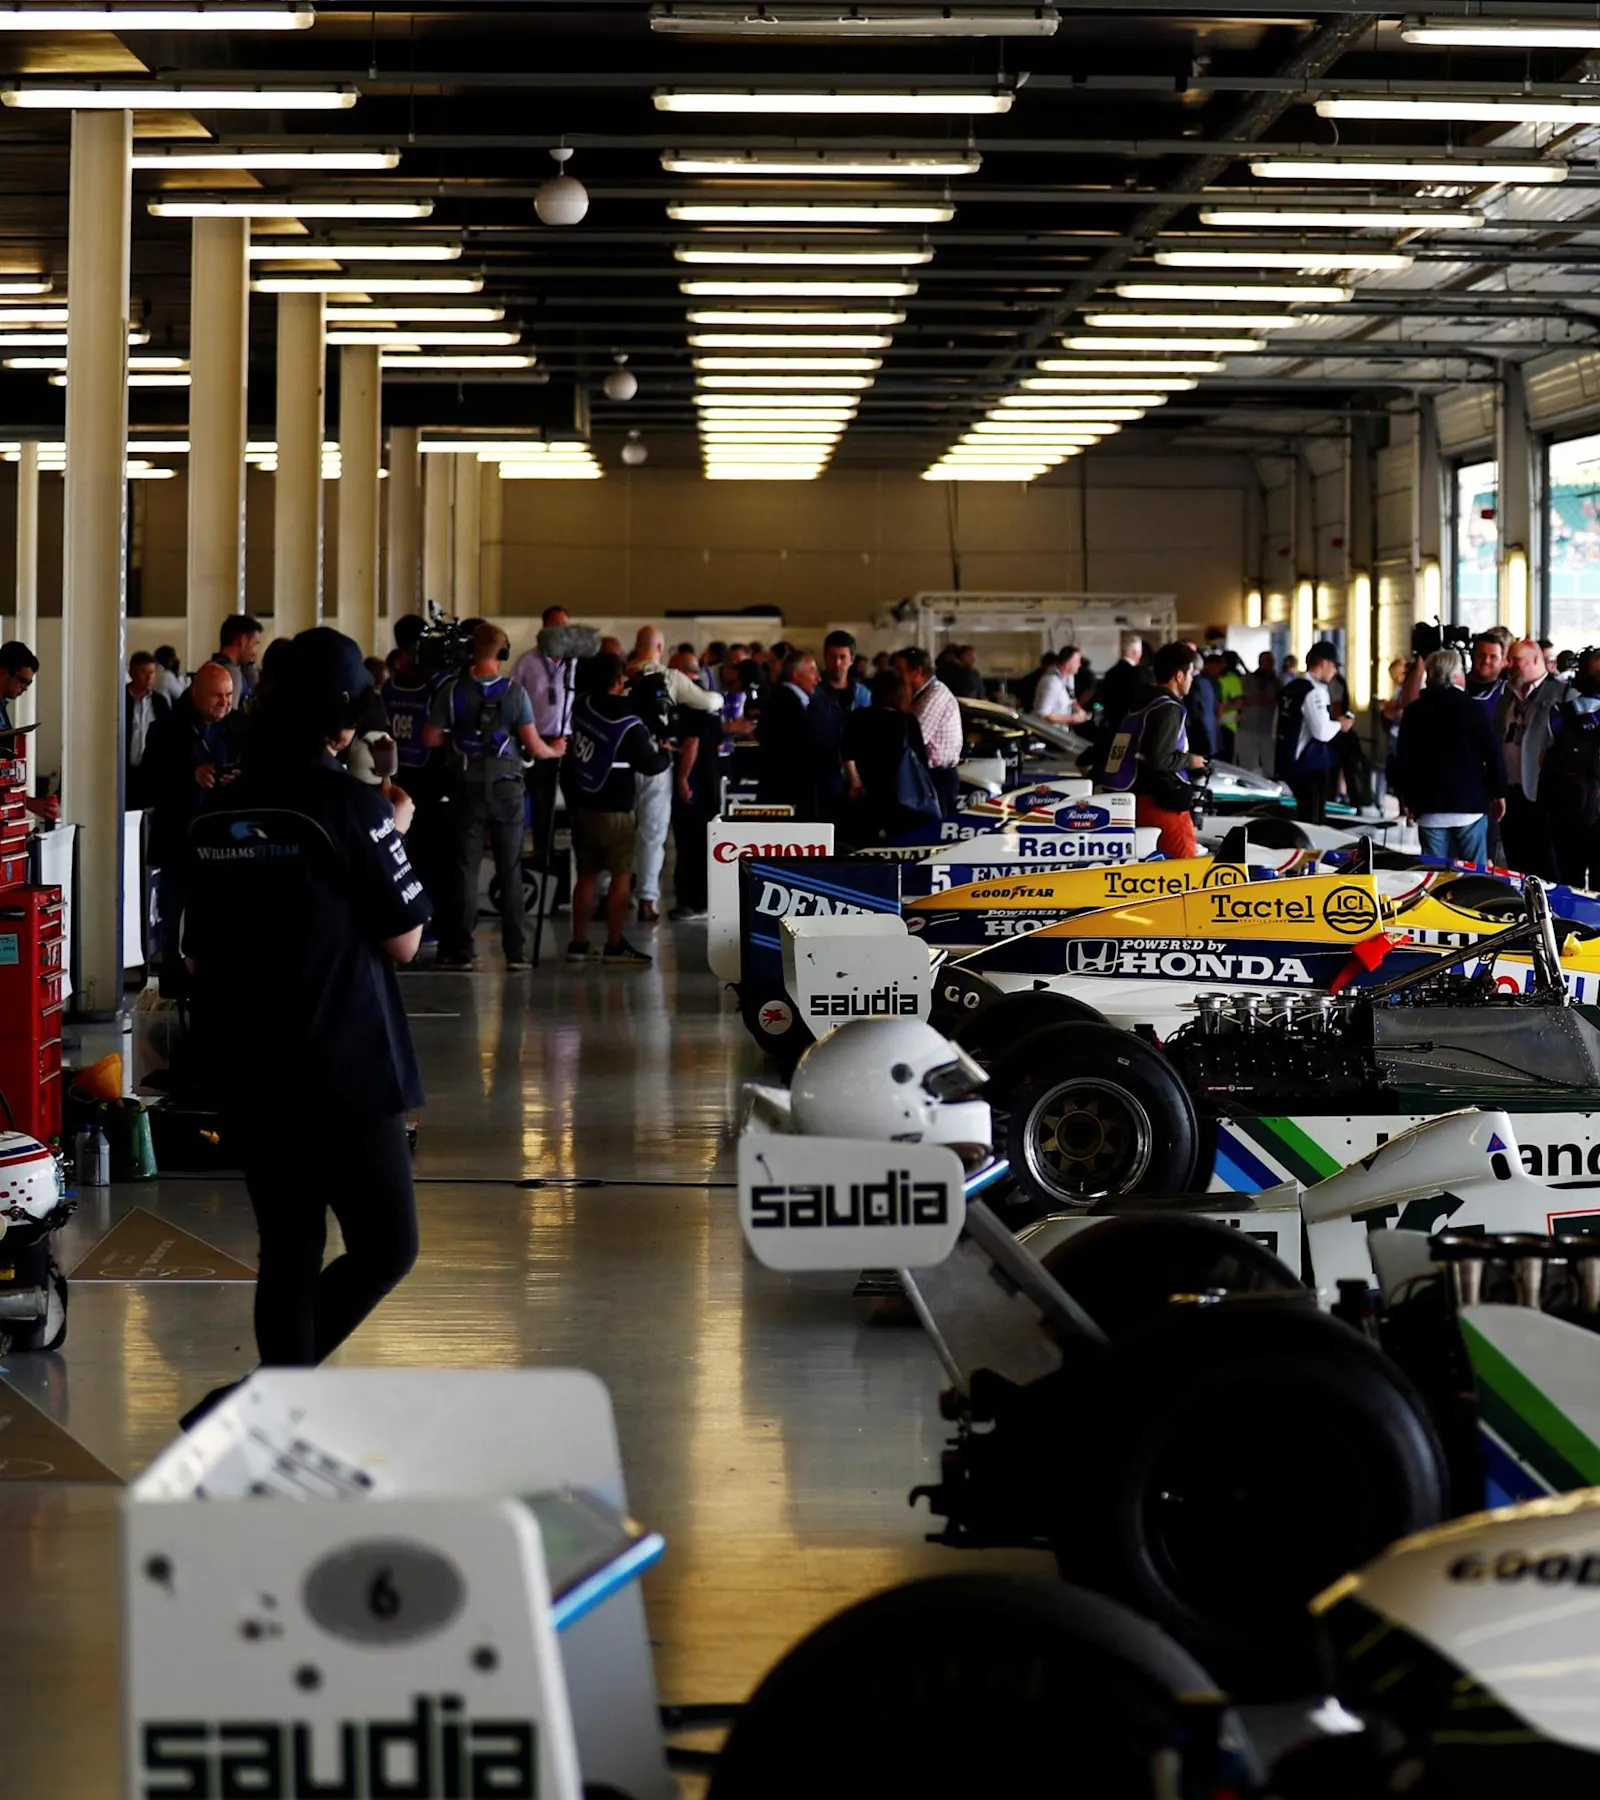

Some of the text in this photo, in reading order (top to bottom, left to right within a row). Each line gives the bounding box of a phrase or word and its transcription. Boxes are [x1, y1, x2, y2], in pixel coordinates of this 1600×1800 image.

[1067, 807, 1099, 820] Racing
[941, 822, 992, 841] Rac
[1018, 836, 1124, 858] Racing
[931, 865, 951, 896] 5
[970, 885, 1054, 899] GOODYEAR
[1211, 893, 1315, 919] Tactel
[1336, 895, 1364, 911] ICI
[1120, 938, 1227, 953] POWERED by
[1117, 952, 1314, 984] HONDA
[810, 986, 919, 1016] saudia
[945, 984, 980, 1009] GO
[751, 1169, 948, 1229] saudia
[141, 1692, 536, 1800] saudia
